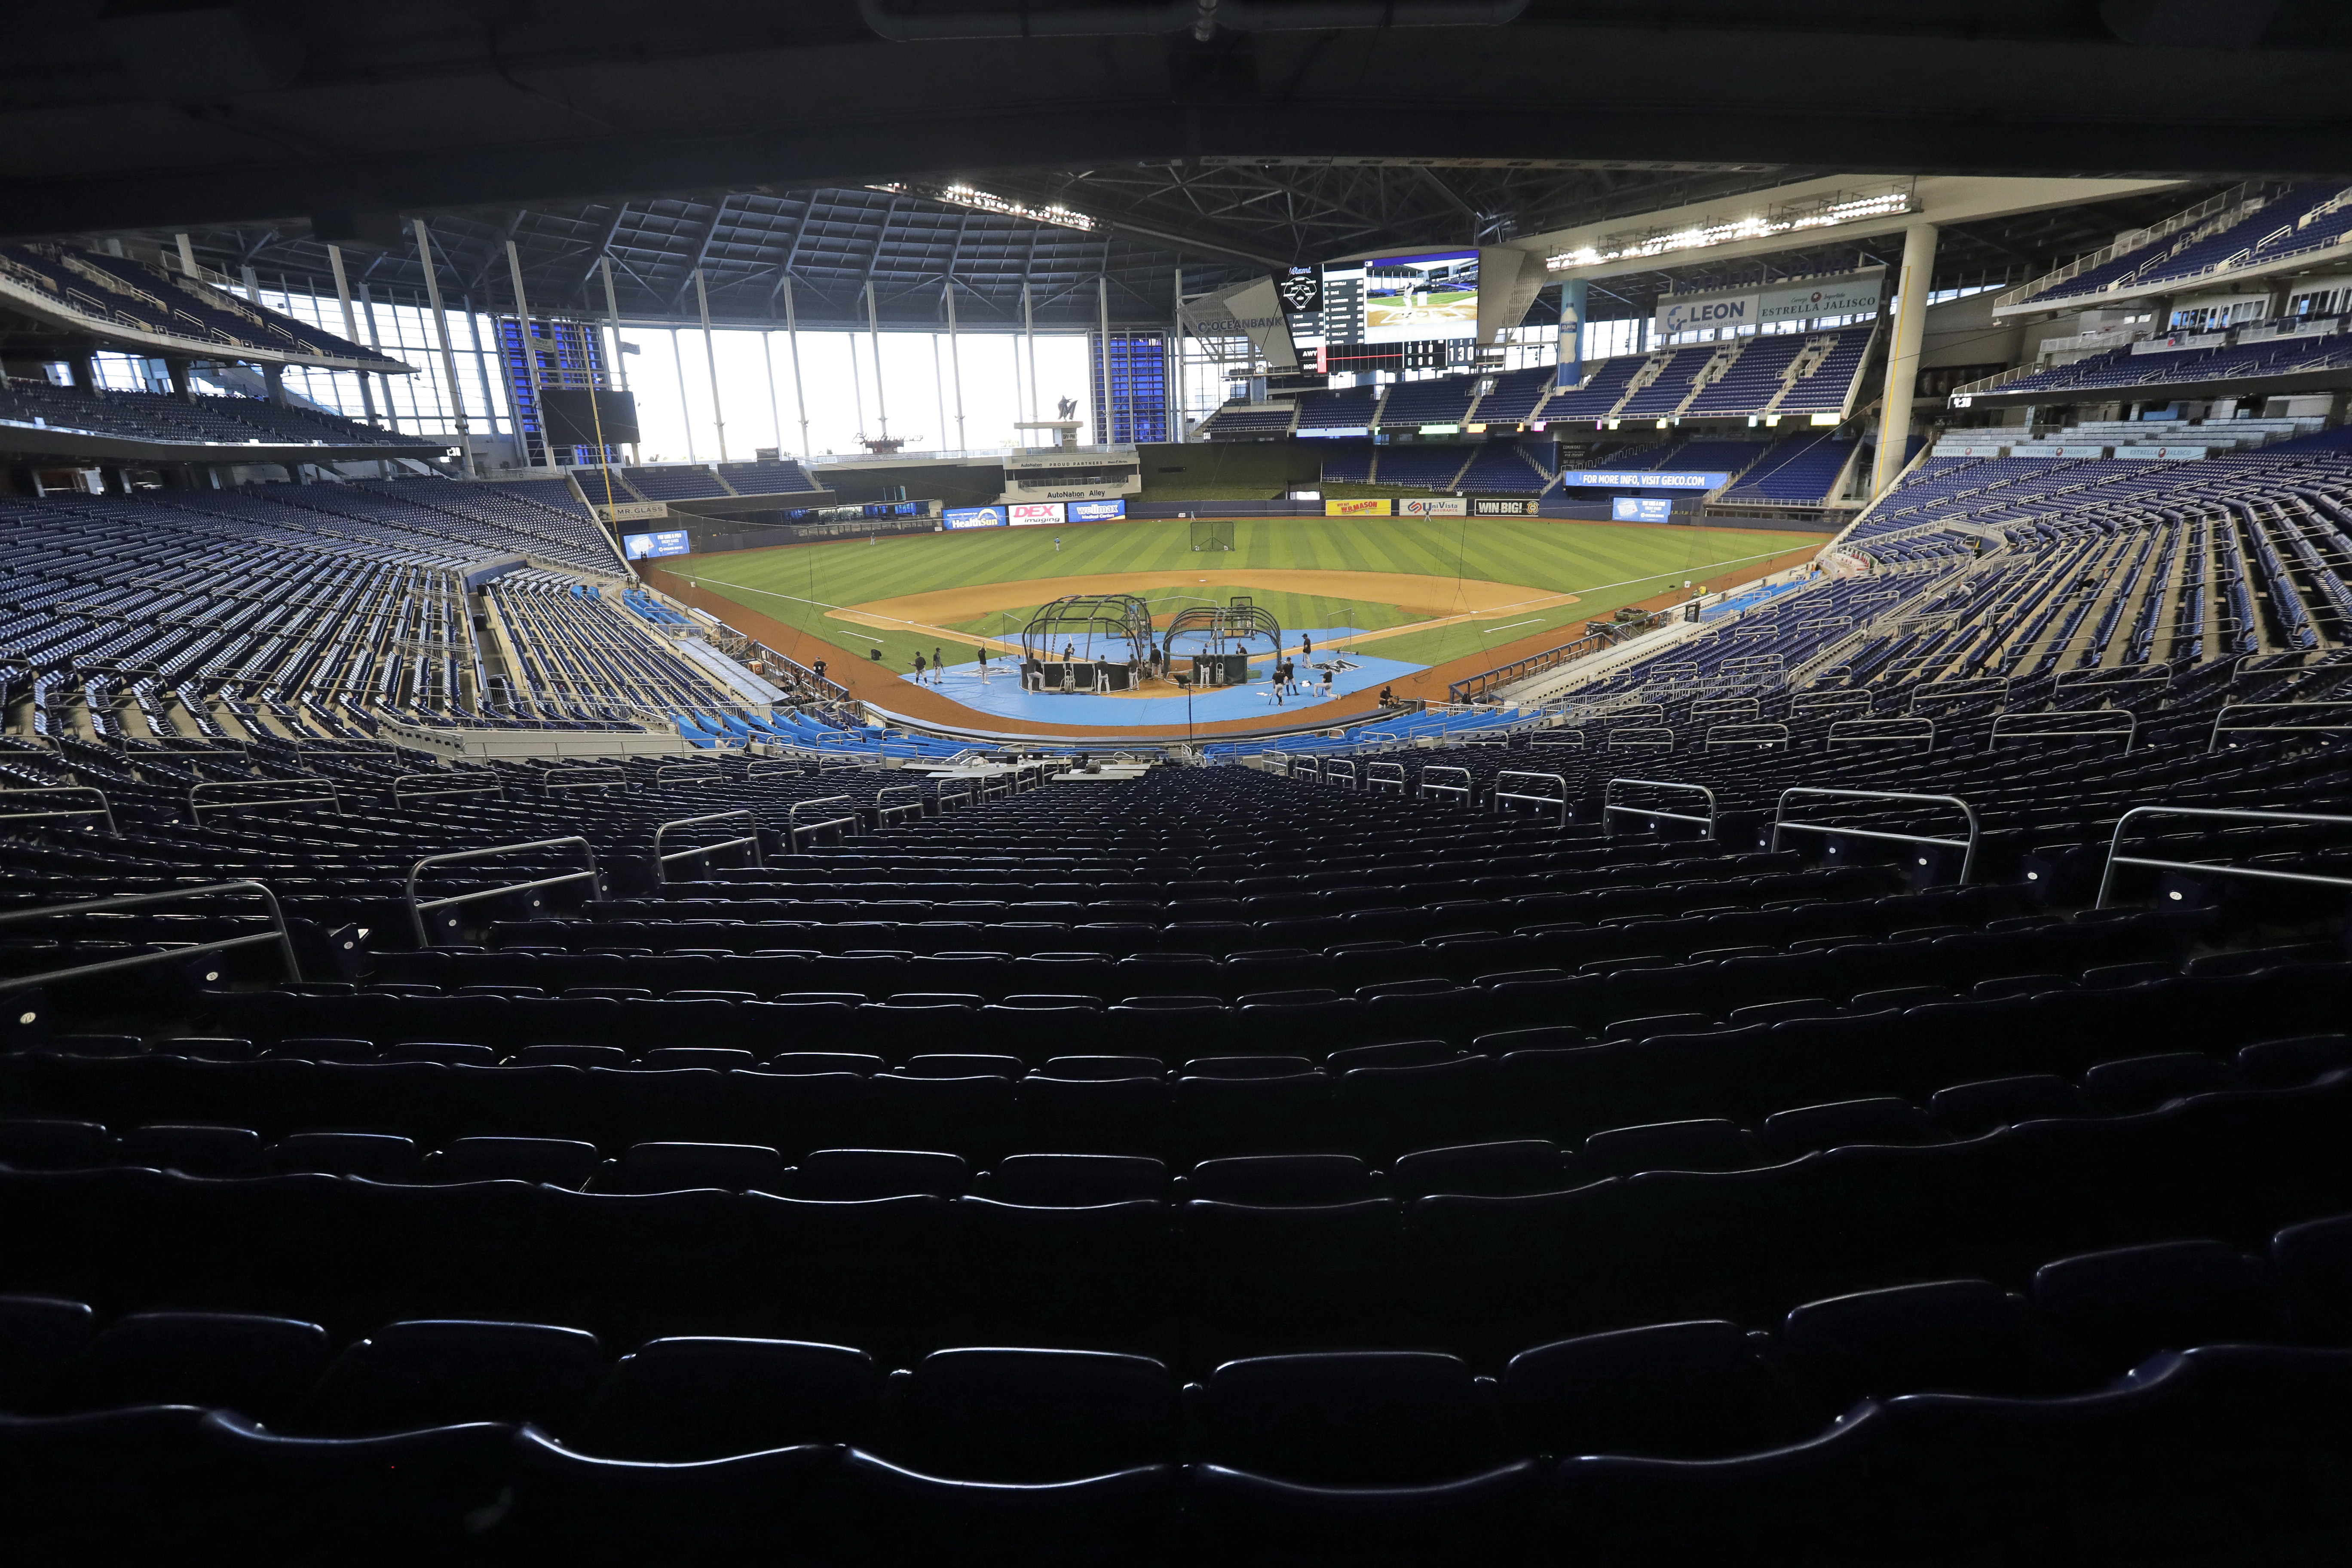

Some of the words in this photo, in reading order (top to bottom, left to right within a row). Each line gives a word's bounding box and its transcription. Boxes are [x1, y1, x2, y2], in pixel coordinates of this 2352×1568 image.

[1690, 301, 1745, 322] LEON
[1762, 303, 1819, 317] ESTRELLA
[1824, 297, 1875, 310] JALISCO
[1408, 346, 1412, 354] 0
[1418, 345, 1423, 353] 0
[1428, 344, 1433, 353] 0
[1449, 347, 1454, 361] 1
[1458, 347, 1465, 361] 3
[1467, 346, 1474, 361] 0
[1408, 358, 1412, 366] 0
[1418, 357, 1423, 365] 0
[1428, 356, 1433, 365] 0
[1583, 475, 1597, 484] FOR
[1599, 475, 1619, 484] MORE
[1620, 475, 1639, 486] INFO,
[1642, 476, 1660, 485] VISIT
[1662, 476, 1705, 486] GEICO.COM
[1014, 505, 1055, 518] DEX
[1077, 504, 1118, 514] wellmax
[1479, 502, 1500, 513] WIN
[1501, 502, 1522, 513] BIG!
[952, 518, 998, 528] HealthSun
